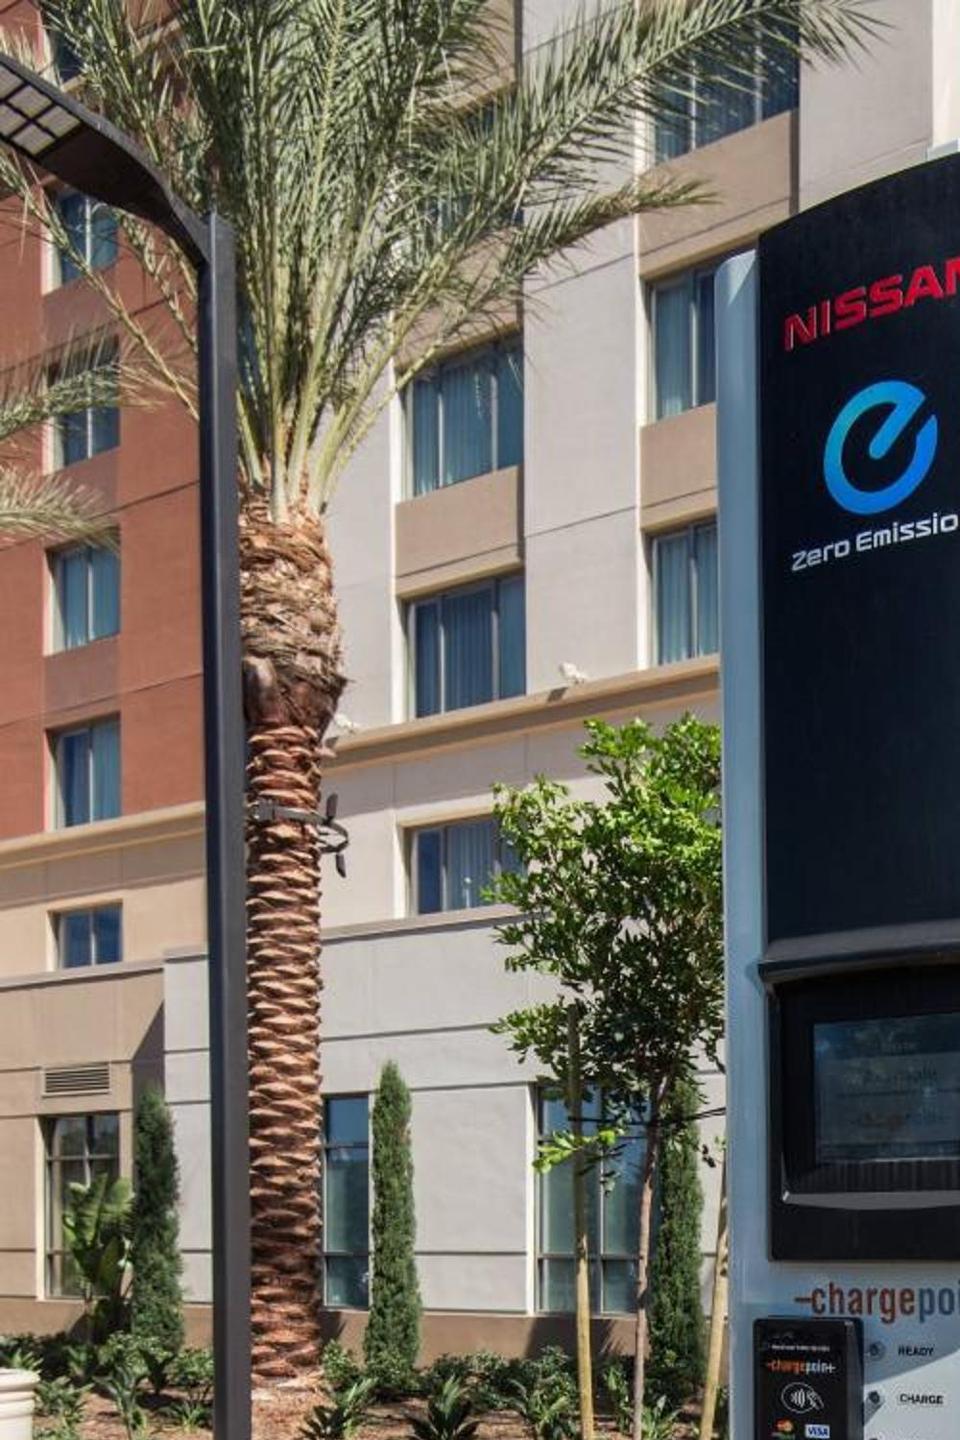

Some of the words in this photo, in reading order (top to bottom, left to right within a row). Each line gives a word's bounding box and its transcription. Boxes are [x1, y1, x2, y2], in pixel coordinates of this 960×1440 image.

[898, 1344, 935, 1356] READY
[900, 1393, 944, 1405] CHARGE
[808, 1425, 828, 1437] VISA
